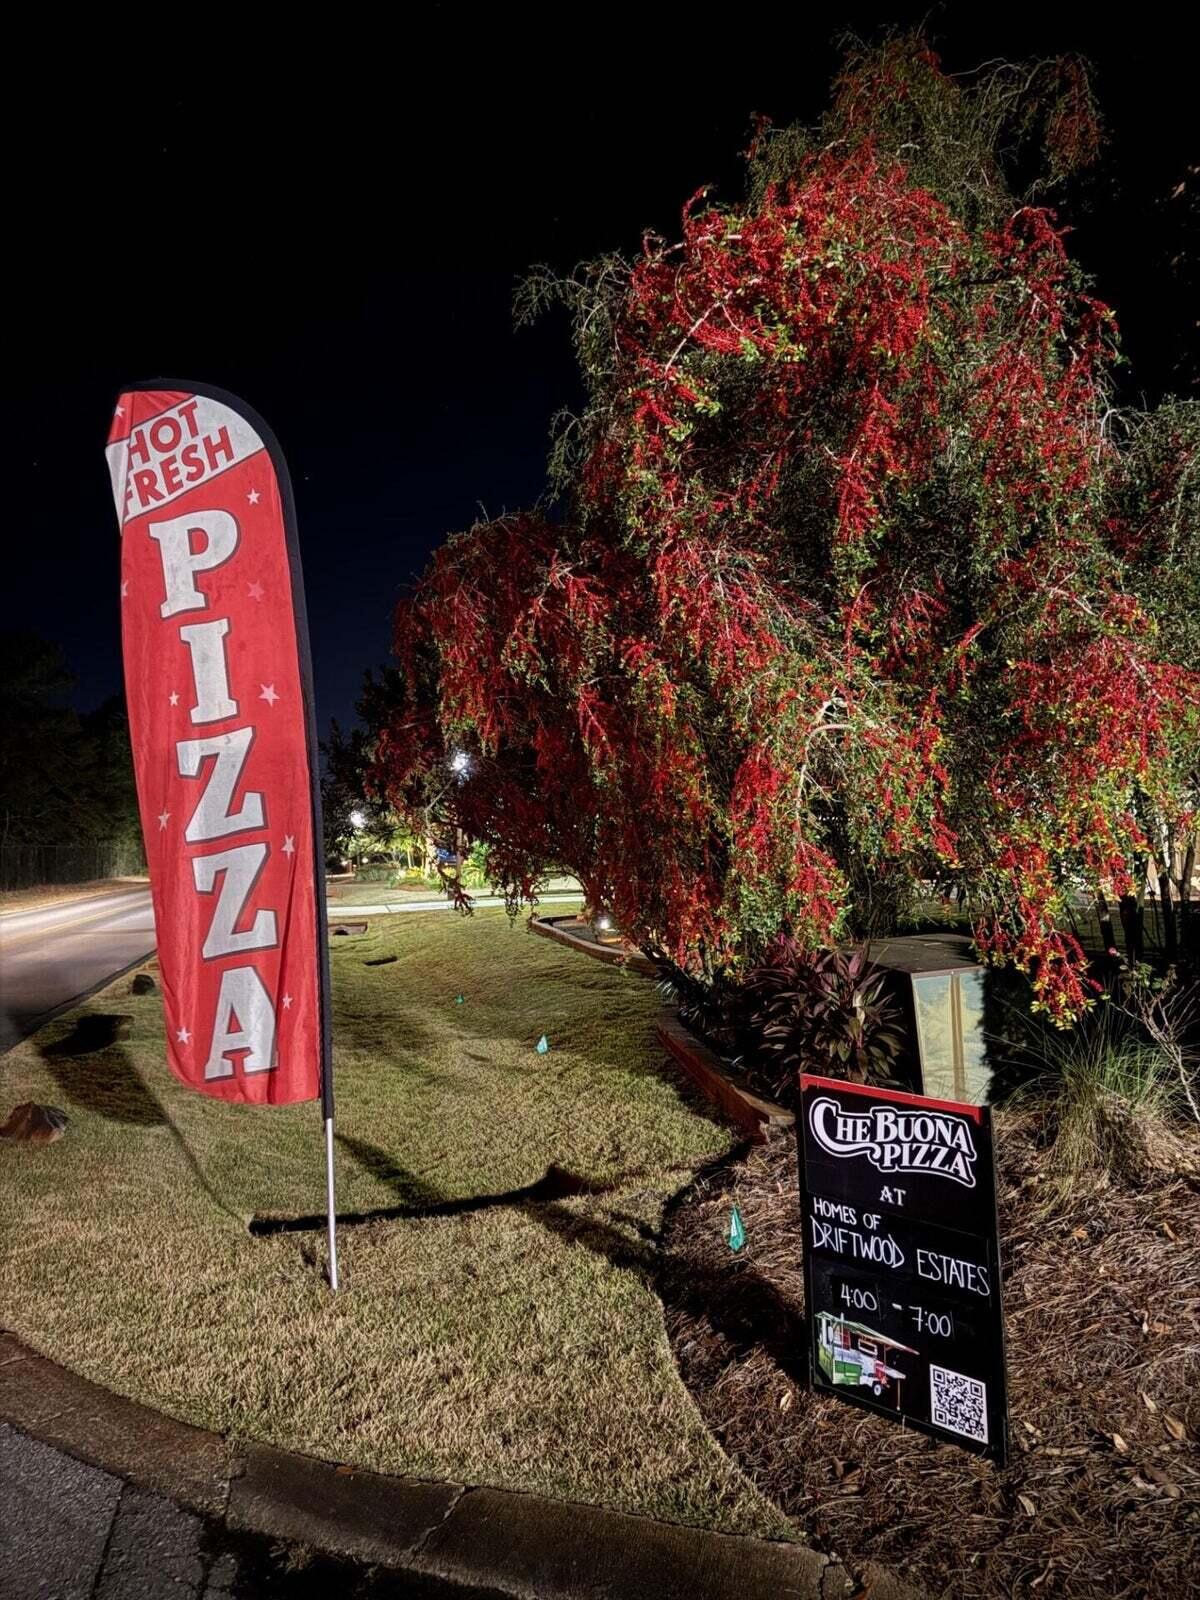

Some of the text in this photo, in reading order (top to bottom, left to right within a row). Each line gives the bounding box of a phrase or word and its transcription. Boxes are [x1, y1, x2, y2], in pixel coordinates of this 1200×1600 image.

[127, 401, 199, 470] HOT
[148, 509, 280, 1081] PIZZA
[882, 1142, 970, 1181] PIZZA
[813, 1196, 881, 1231] HOMES OF
[879, 1185, 906, 1206] AT
[810, 1215, 990, 1296] DRIFTWOOD ESTATES
[841, 1283, 878, 1311] 4:00
[909, 1306, 951, 1337] 7:00
